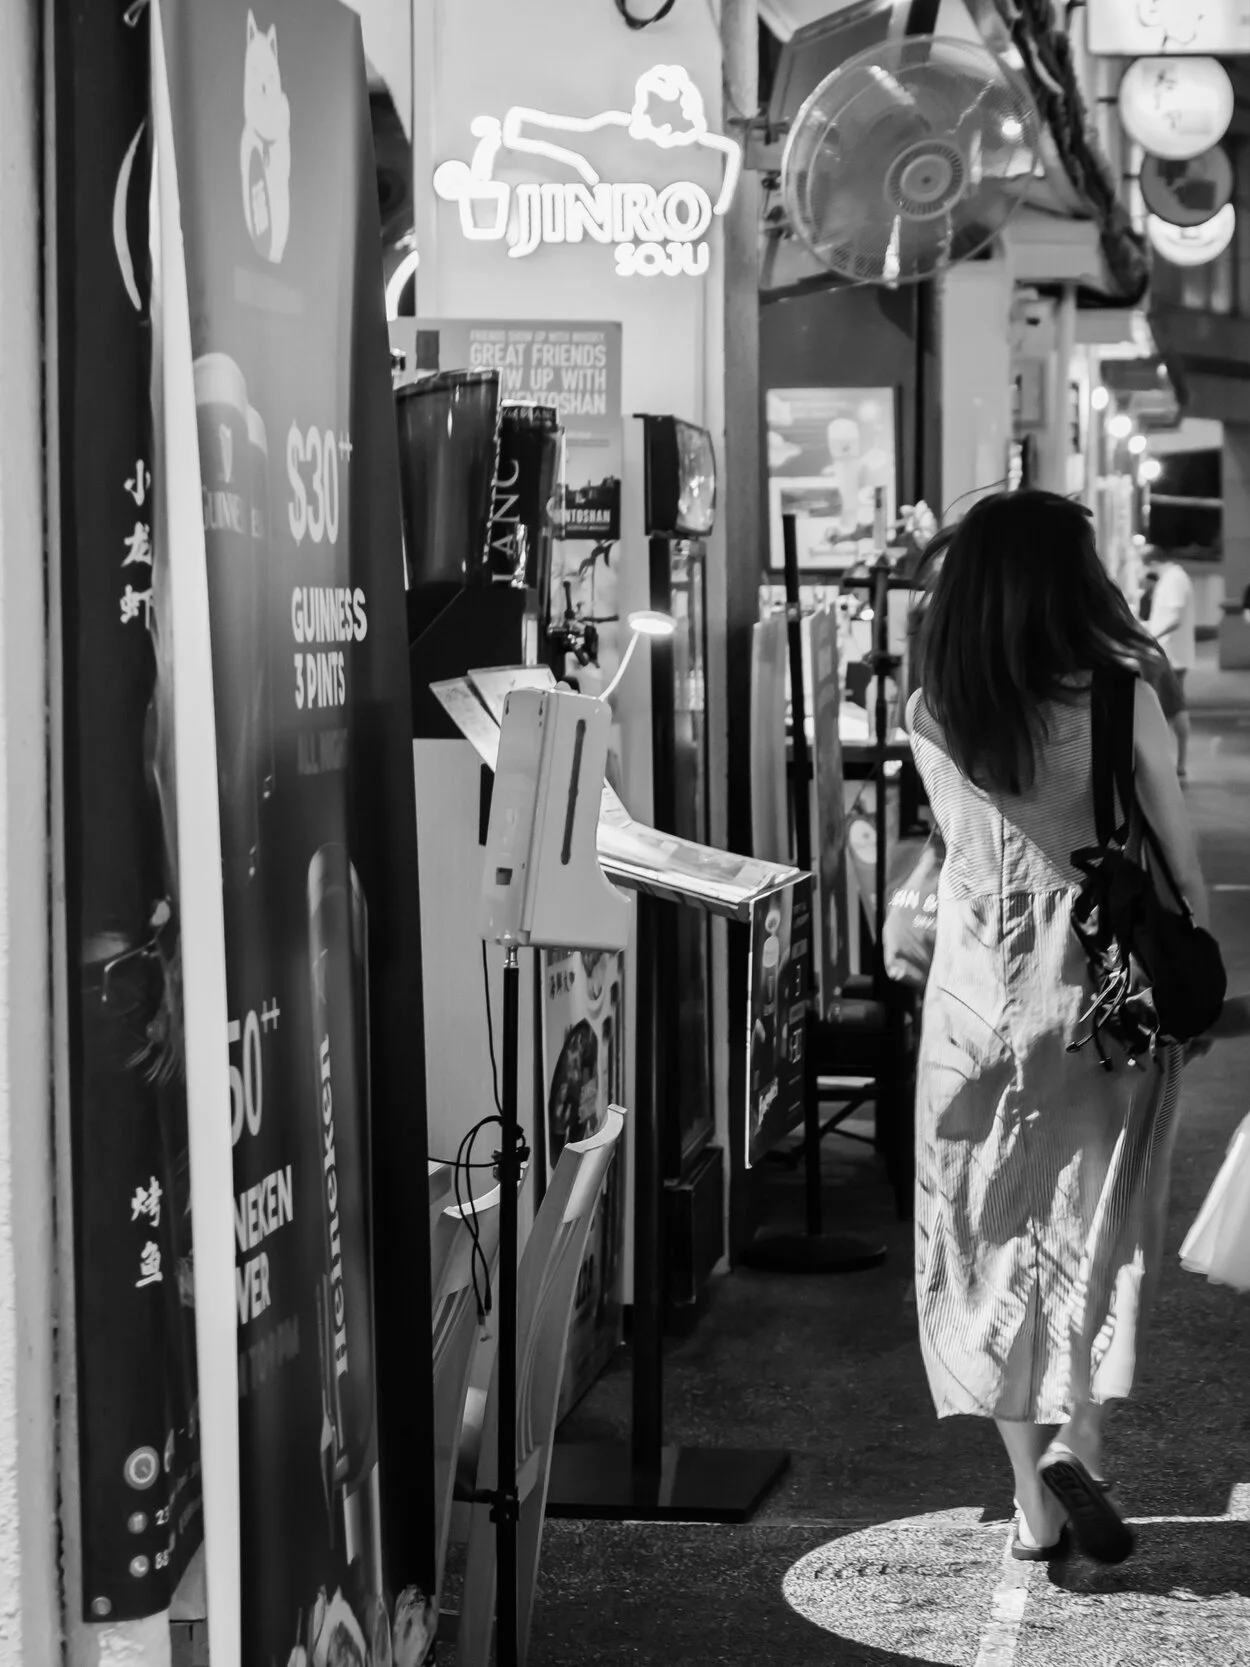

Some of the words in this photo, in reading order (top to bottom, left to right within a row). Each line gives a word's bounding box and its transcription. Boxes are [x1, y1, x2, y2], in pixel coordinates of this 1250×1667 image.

[508, 181, 712, 259] JINRO
[614, 241, 710, 277] SOJU
[470, 342, 527, 366] GREAT
[532, 343, 607, 367] FRIENDS
[530, 367, 554, 390] UP
[561, 367, 607, 391] WITH
[291, 586, 368, 643] GUINNESS
[294, 652, 305, 709] 3
[306, 650, 346, 709] PINTS
[131, 1175, 164, 1288] 烤鱼
[233, 1164, 294, 1253] NEKEN
[319, 1032, 349, 1379] Heineken
